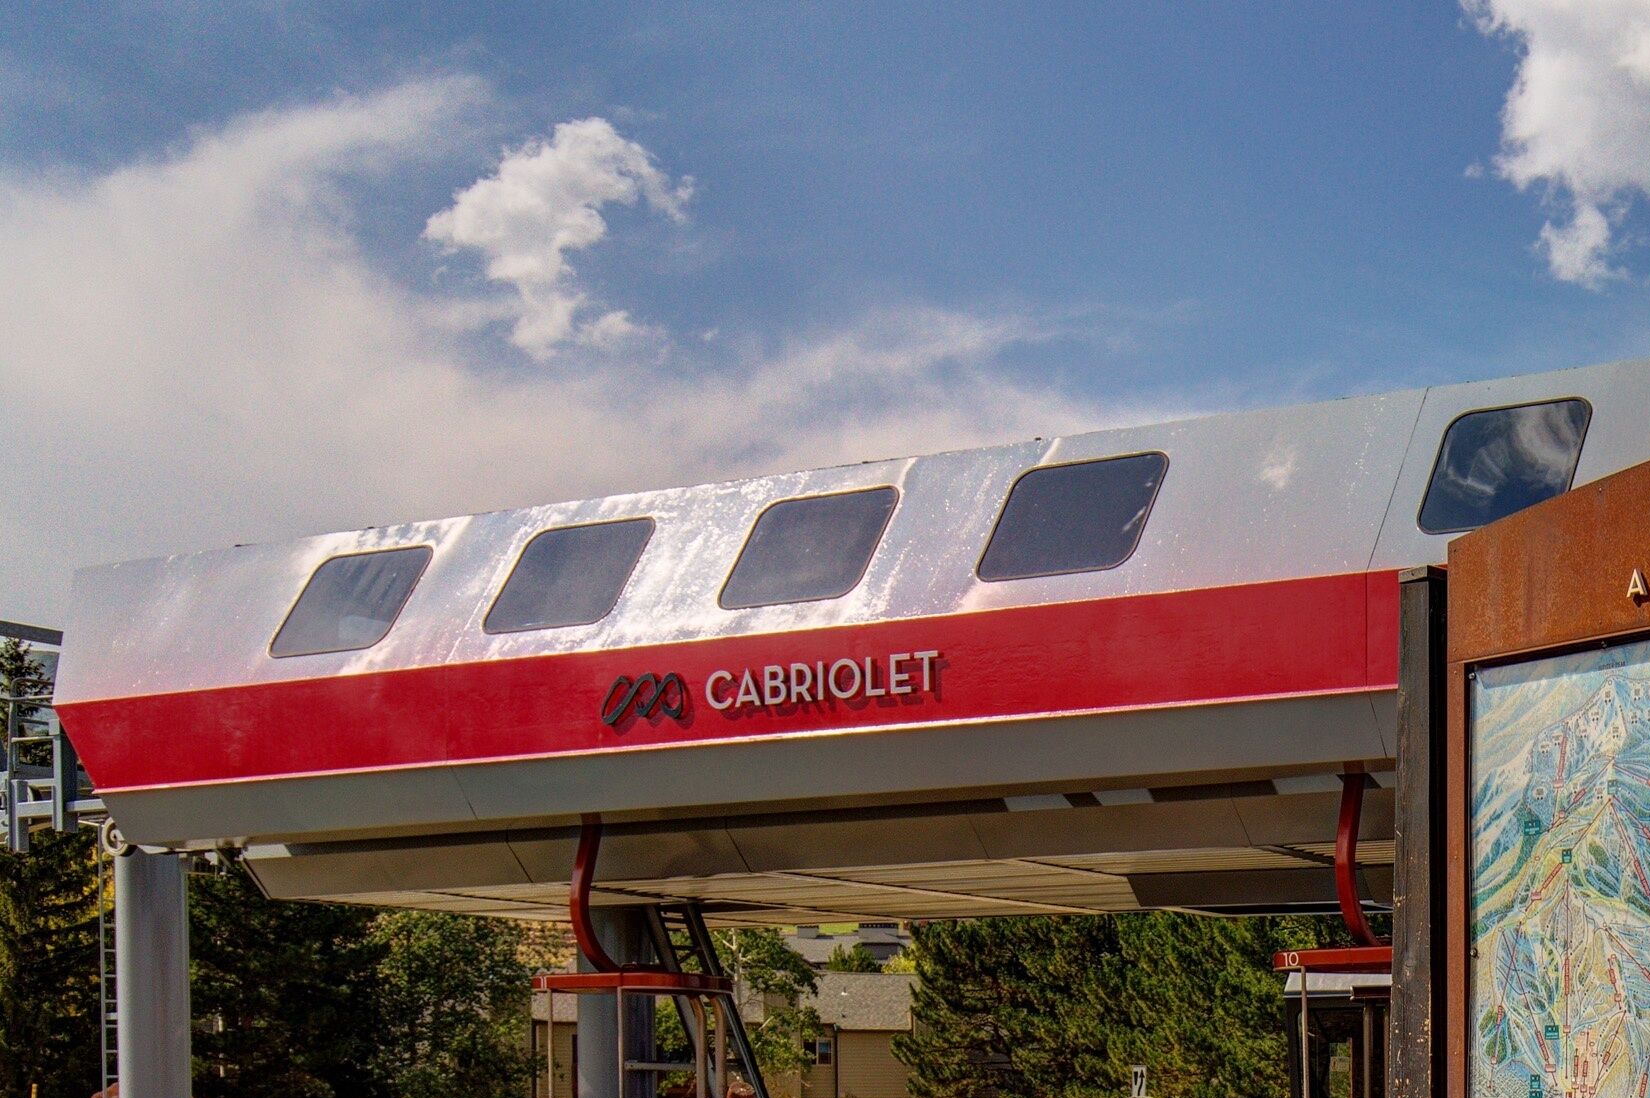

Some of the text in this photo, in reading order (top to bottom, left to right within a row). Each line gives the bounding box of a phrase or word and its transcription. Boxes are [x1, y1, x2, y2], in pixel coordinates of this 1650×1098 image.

[1626, 568, 1649, 599] A
[706, 650, 940, 711] CABRIOLET
[1283, 952, 1298, 966] 10
